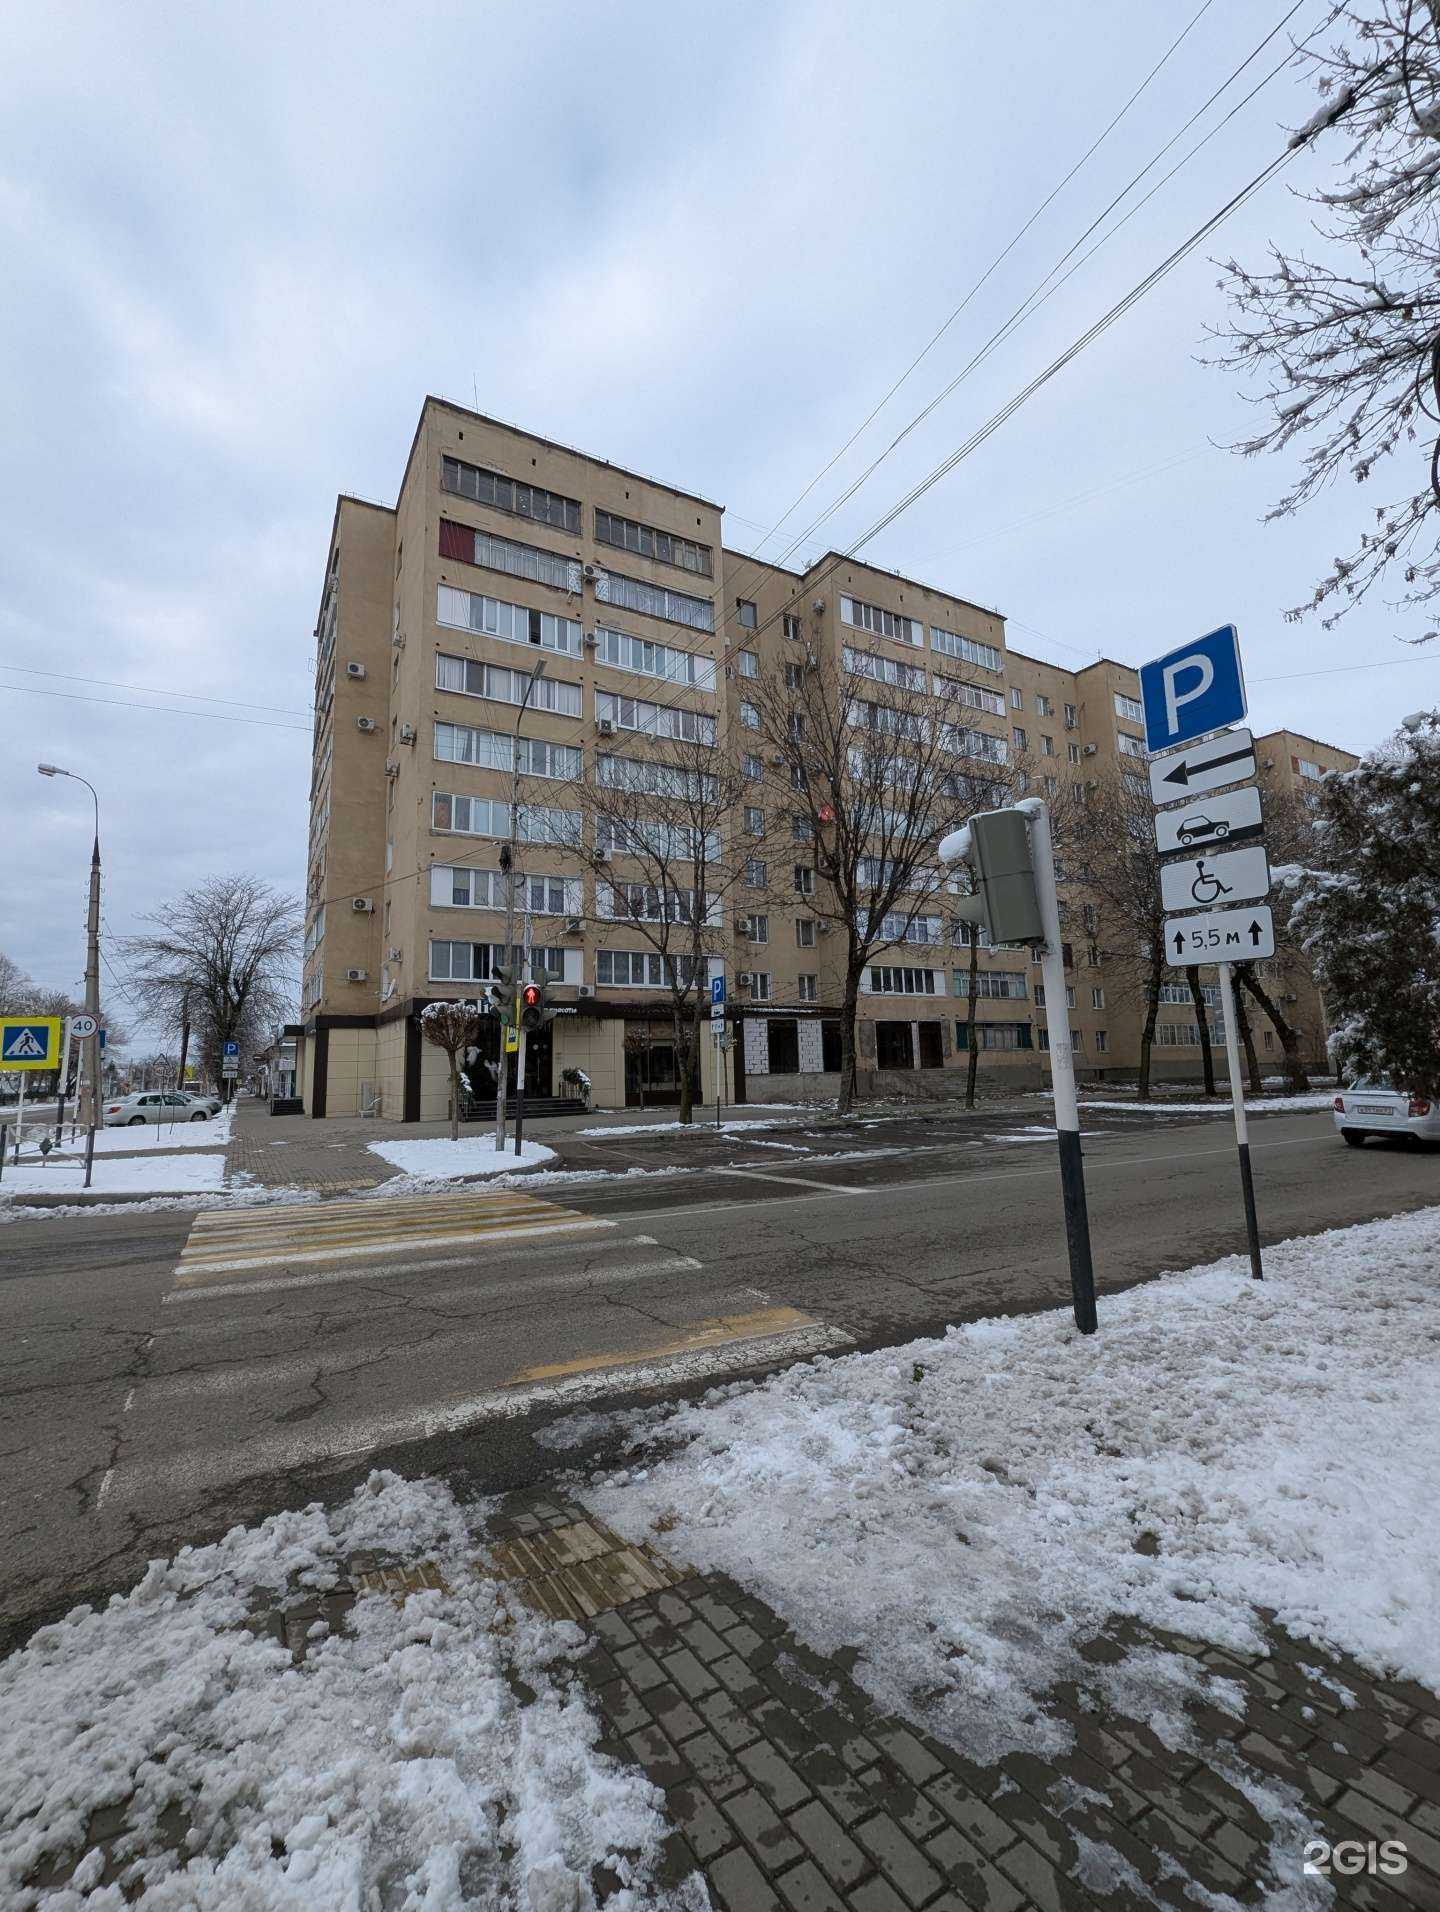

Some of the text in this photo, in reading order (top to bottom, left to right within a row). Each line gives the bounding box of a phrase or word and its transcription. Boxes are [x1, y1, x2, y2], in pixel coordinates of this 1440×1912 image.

[1163, 654, 1214, 736] P
[1191, 929, 1220, 950] 5,5
[713, 980, 721, 1001] P
[73, 1020, 93, 1032] 40
[227, 1043, 236, 1055] P
